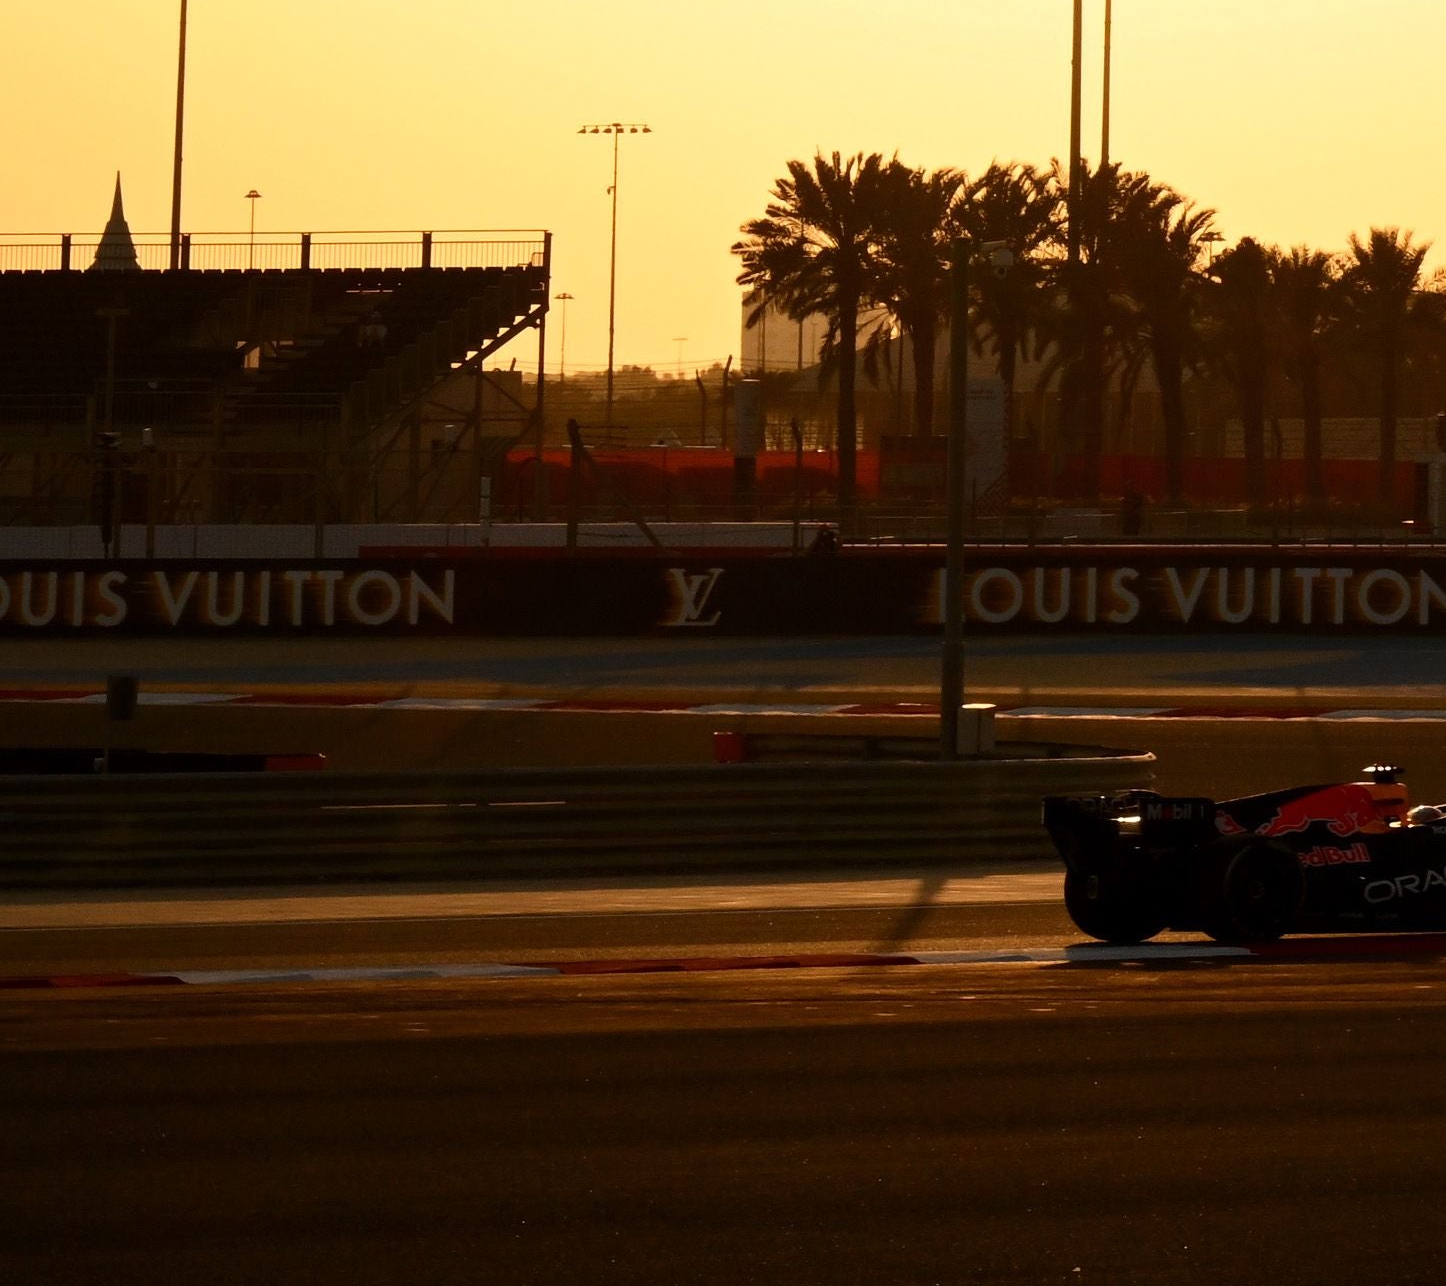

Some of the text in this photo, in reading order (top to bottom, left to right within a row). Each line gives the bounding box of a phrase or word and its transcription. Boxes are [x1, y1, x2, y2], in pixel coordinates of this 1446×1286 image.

[0, 569, 455, 627] UIS VUITTON
[1146, 802, 1192, 821] Mobil
[1323, 841, 1372, 864] Bull
